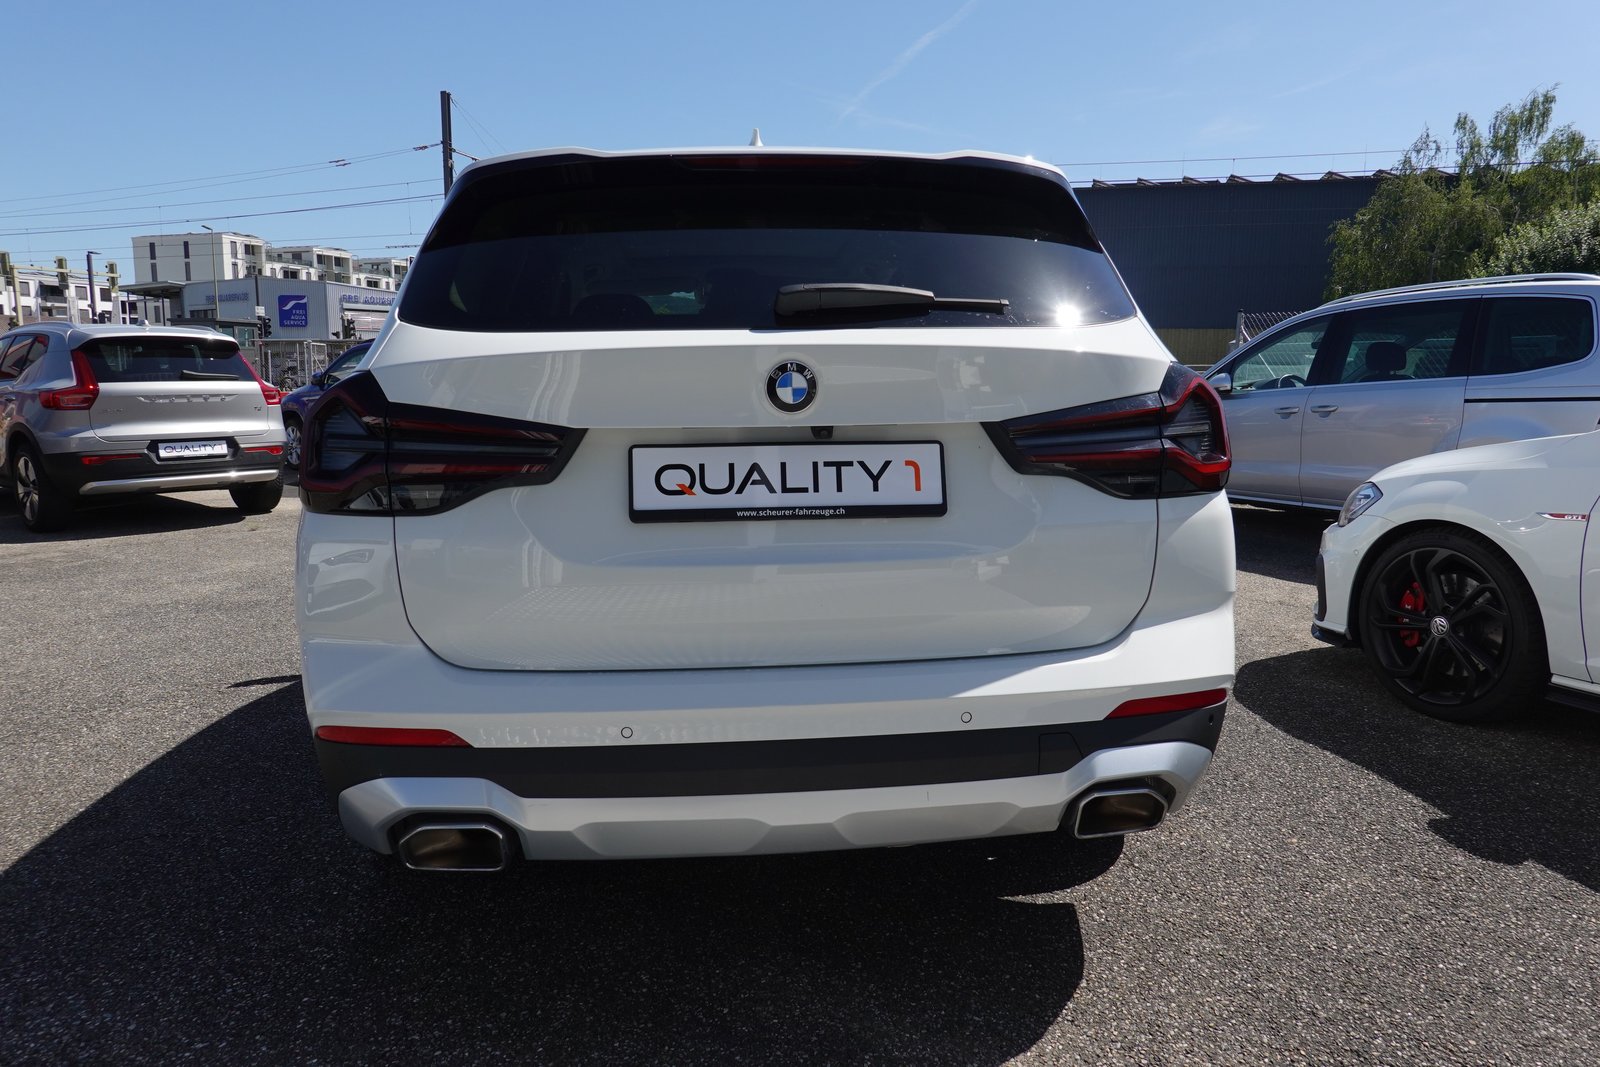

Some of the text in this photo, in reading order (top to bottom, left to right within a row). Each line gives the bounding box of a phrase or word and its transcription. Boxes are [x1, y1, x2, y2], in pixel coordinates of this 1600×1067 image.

[770, 363, 813, 380] BMW
[164, 443, 217, 454] QUALITY
[654, 459, 893, 496] QUALITY
[736, 507, 846, 518] www.scheurer-fahrzeuge.ch
